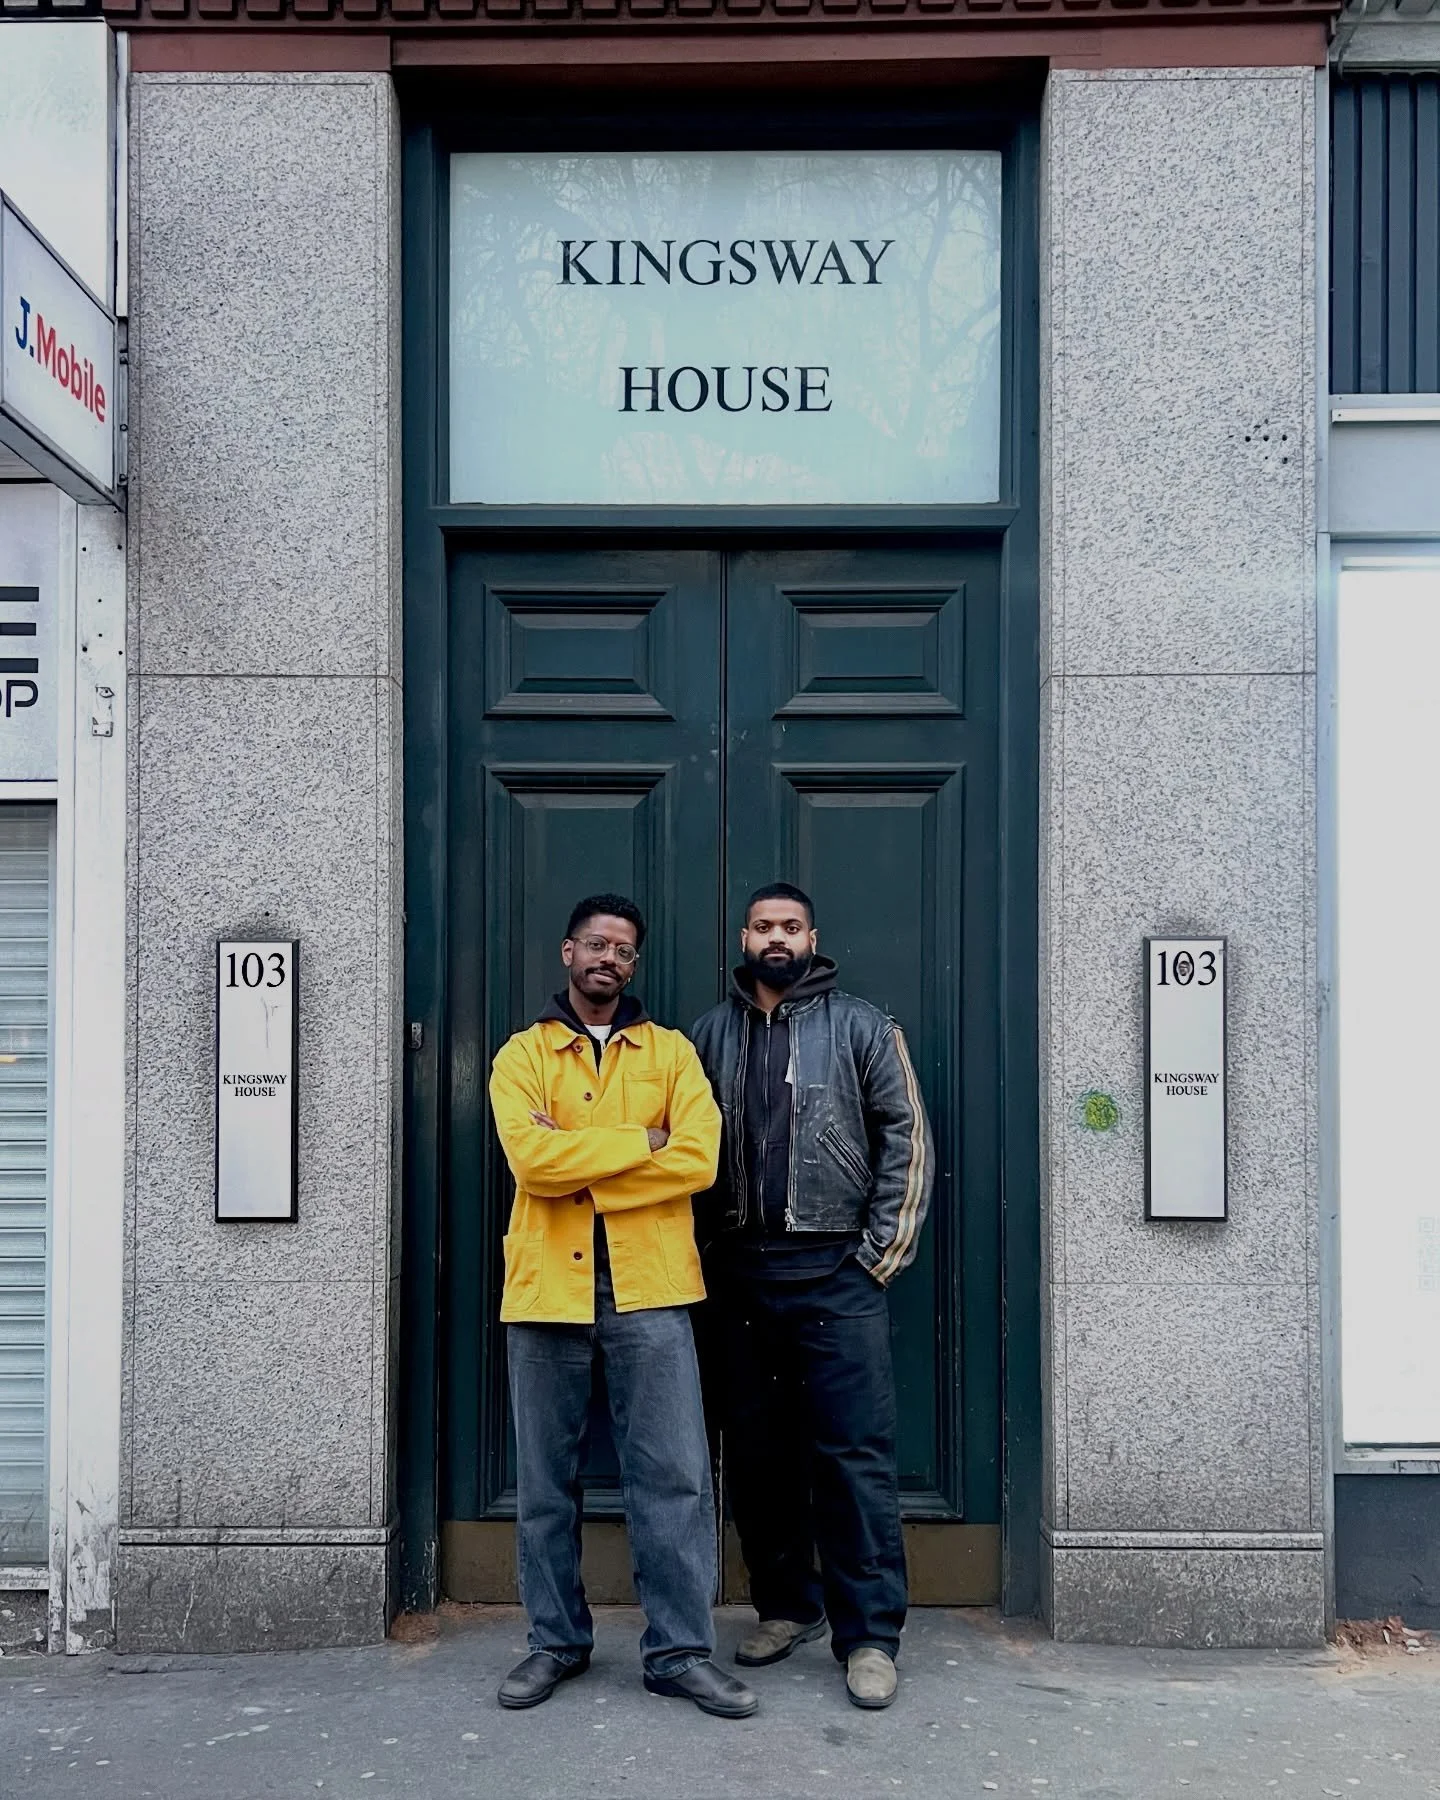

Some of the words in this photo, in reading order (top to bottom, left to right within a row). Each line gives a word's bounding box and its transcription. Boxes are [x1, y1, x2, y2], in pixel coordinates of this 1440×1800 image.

[556, 239, 896, 286] KINGSWAY
[15, 296, 106, 423] J.Mobile
[617, 366, 833, 413] HOUSE
[0, 679, 39, 718] P
[225, 952, 286, 988] 103
[1156, 950, 1217, 986] 103
[222, 1074, 287, 1085] KINGSWAY
[234, 1086, 276, 1097] HOUSE
[1153, 1072, 1220, 1084] KINGSWAY
[1166, 1085, 1208, 1096] HOUSE
